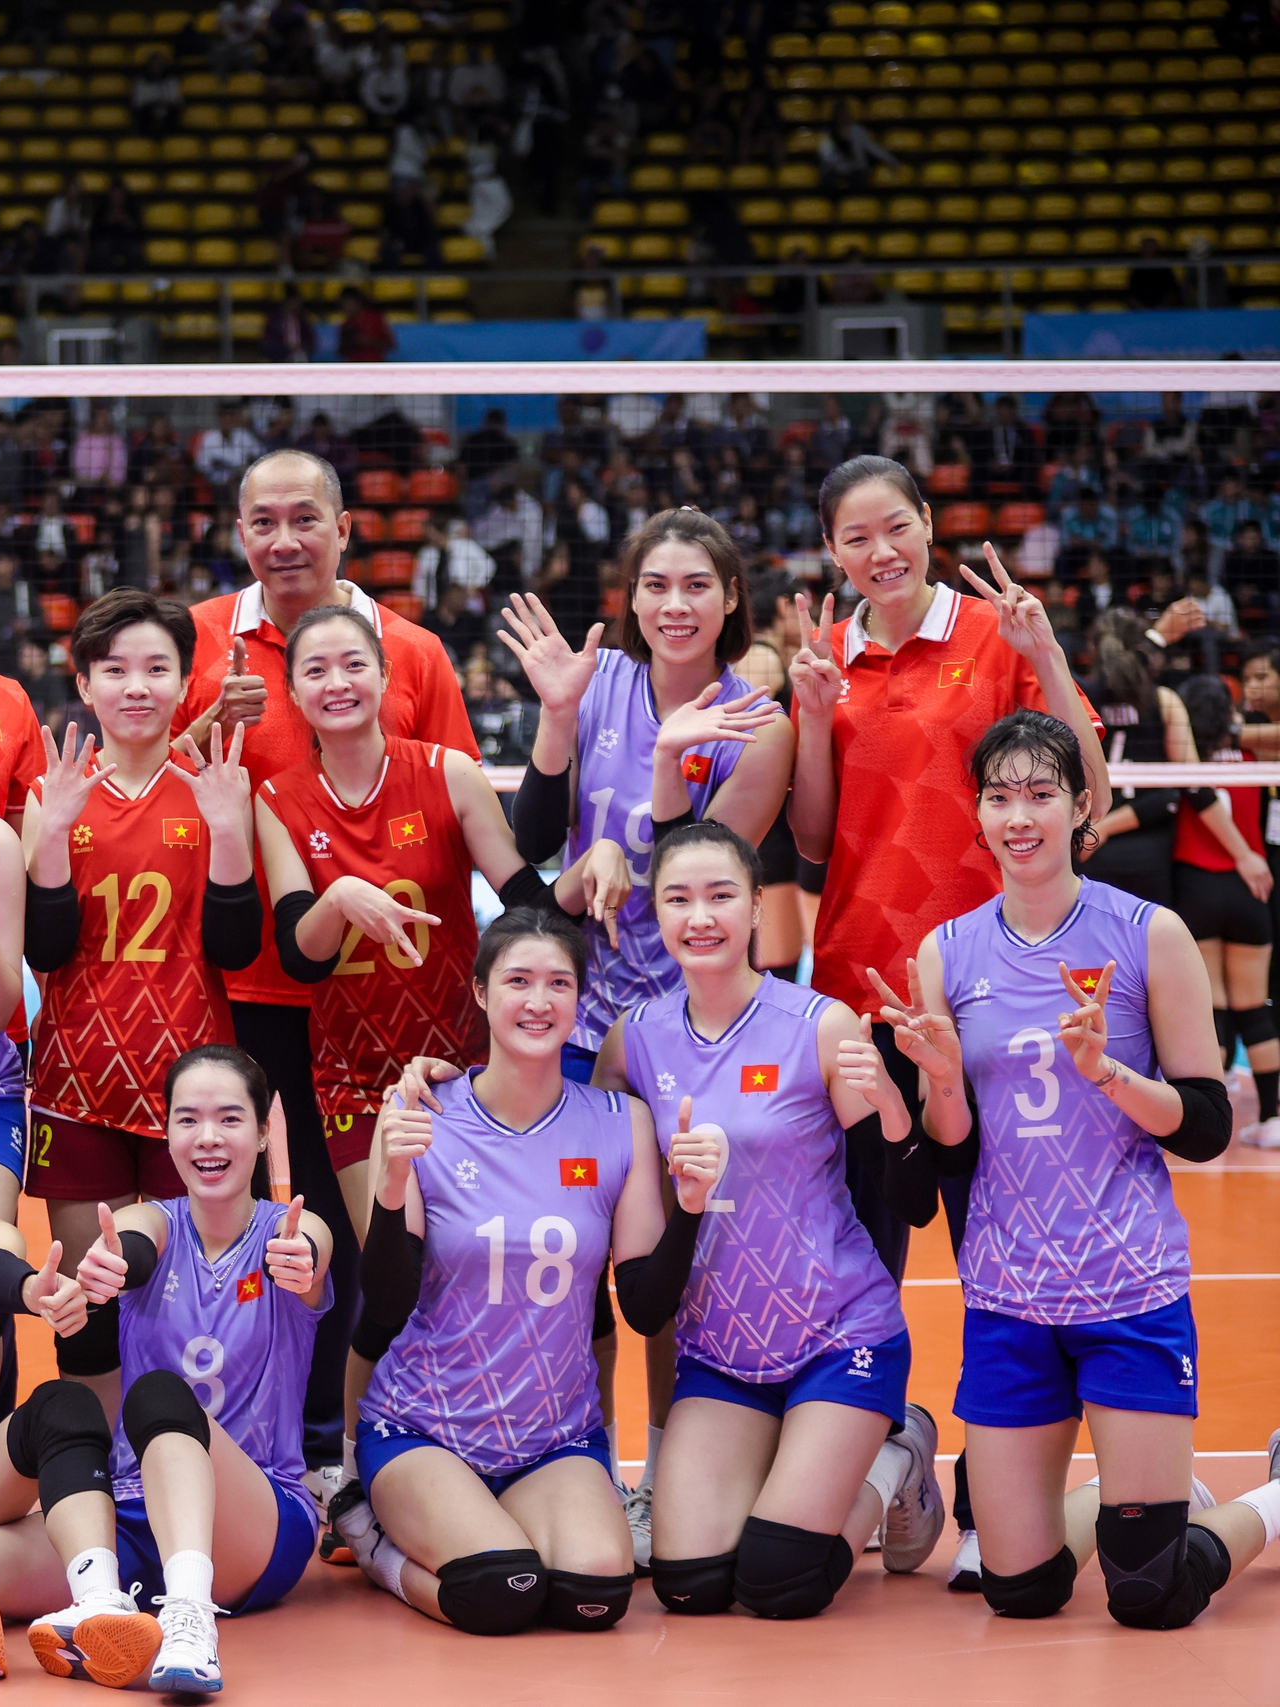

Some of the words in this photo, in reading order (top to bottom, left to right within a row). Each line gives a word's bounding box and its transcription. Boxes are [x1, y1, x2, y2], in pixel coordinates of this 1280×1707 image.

[91, 871, 173, 963] 12
[1008, 1027, 1060, 1121] 3
[475, 1215, 579, 1307] 18
[181, 1335, 226, 1419] 8
